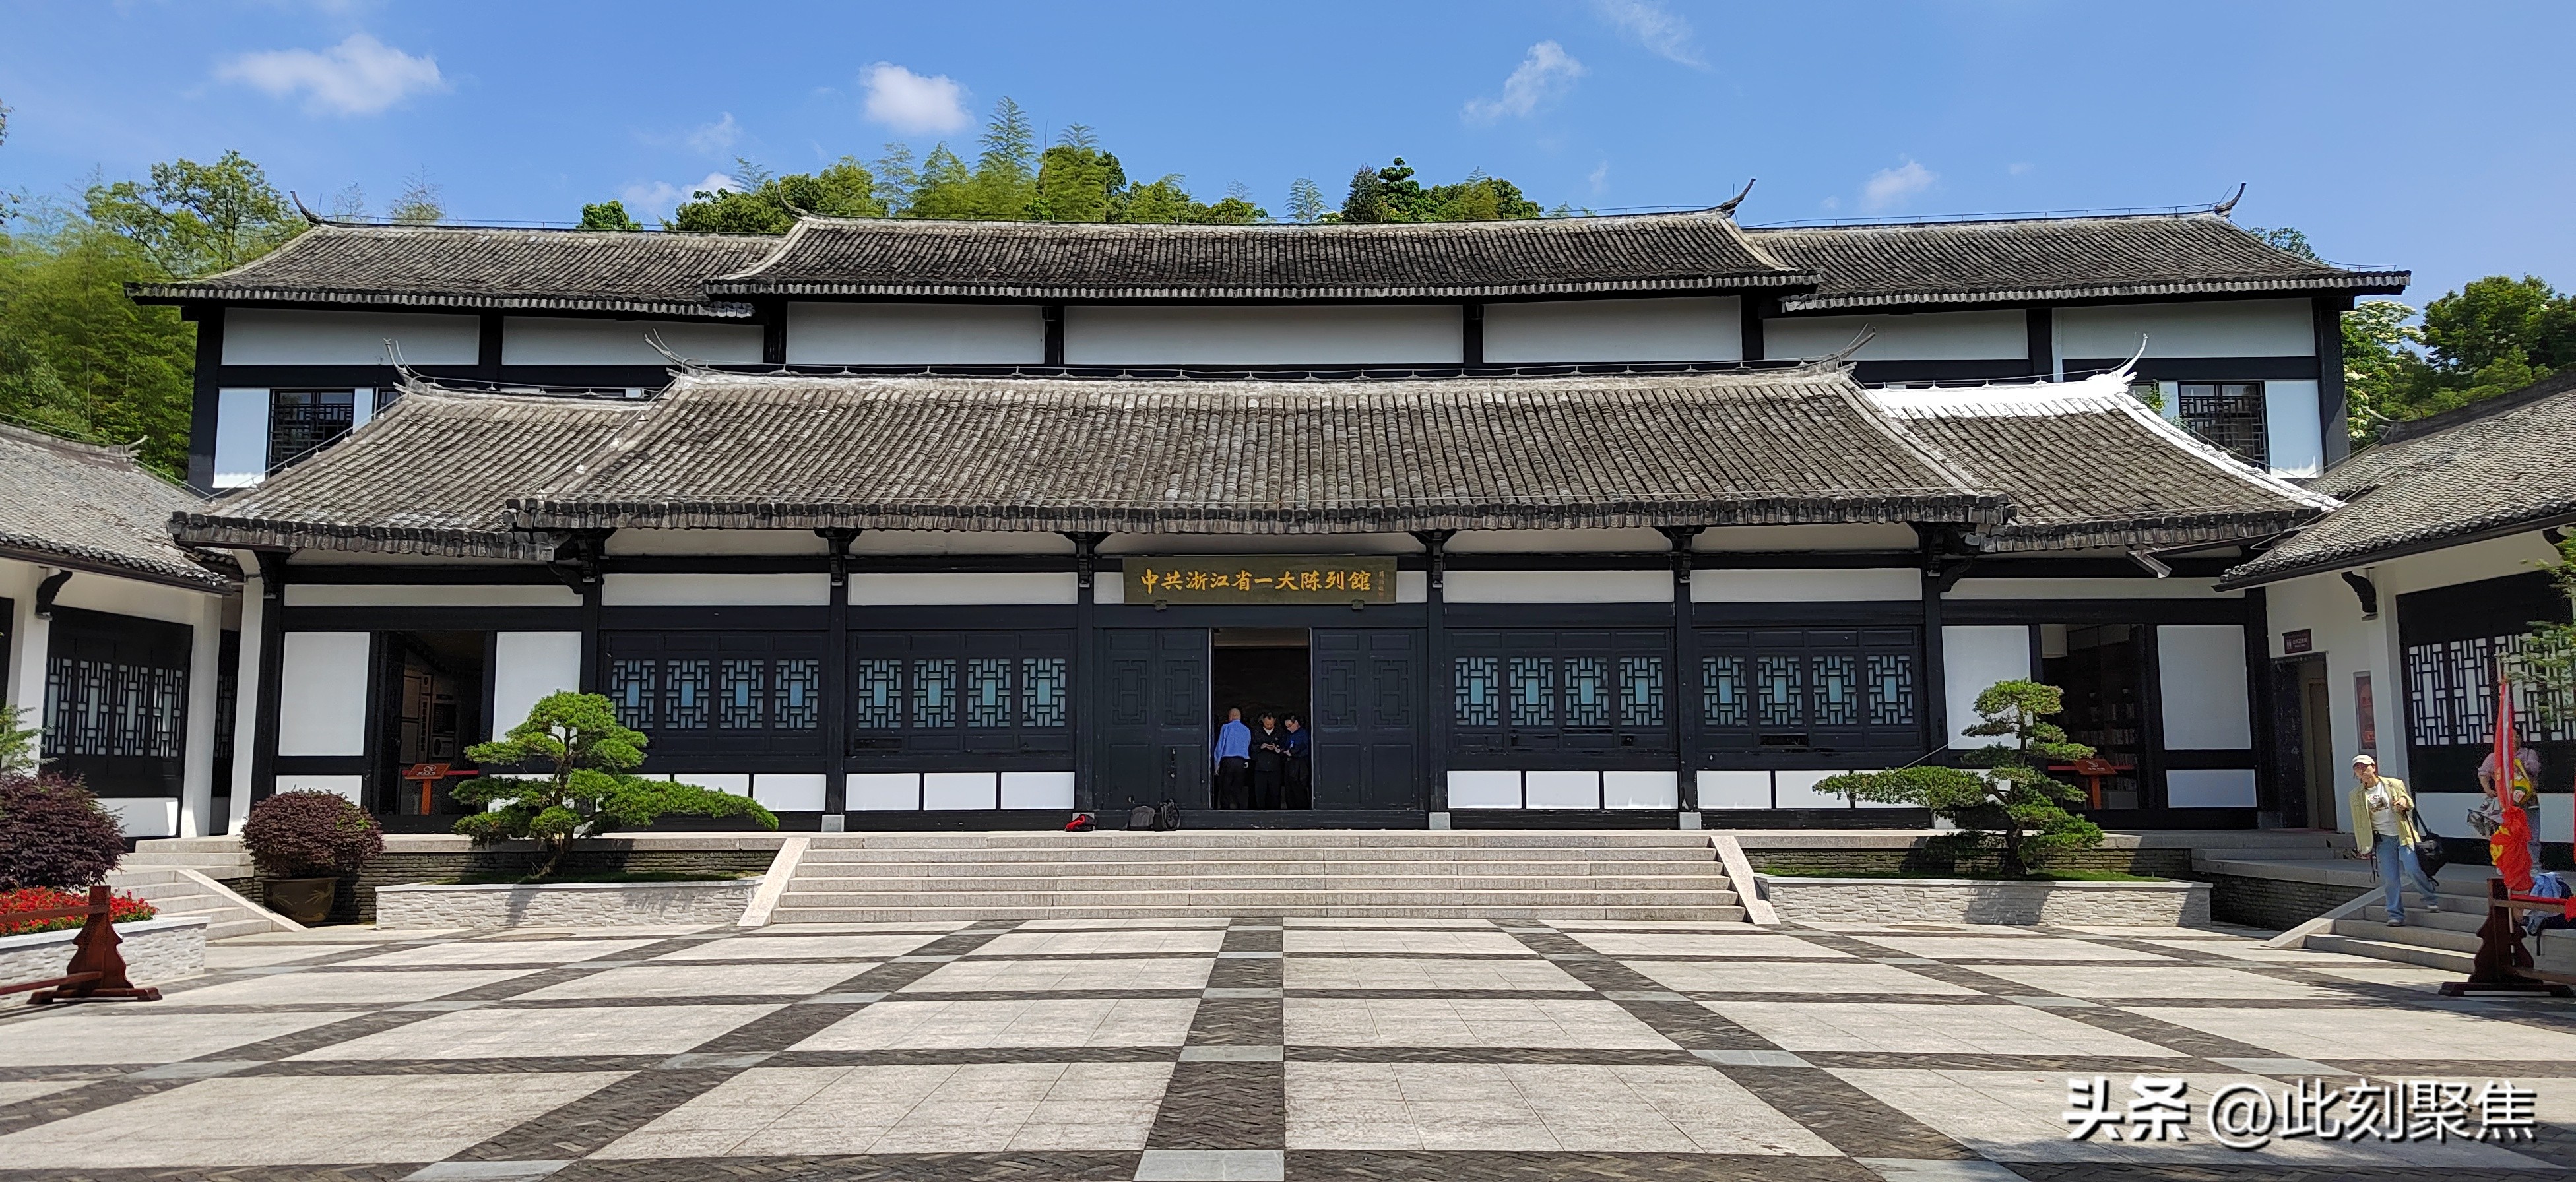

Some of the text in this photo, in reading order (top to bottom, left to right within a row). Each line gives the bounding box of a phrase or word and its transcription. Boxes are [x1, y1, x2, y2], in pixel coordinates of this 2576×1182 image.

[1141, 569, 1372, 593] 中共浙江省一大陈列館
